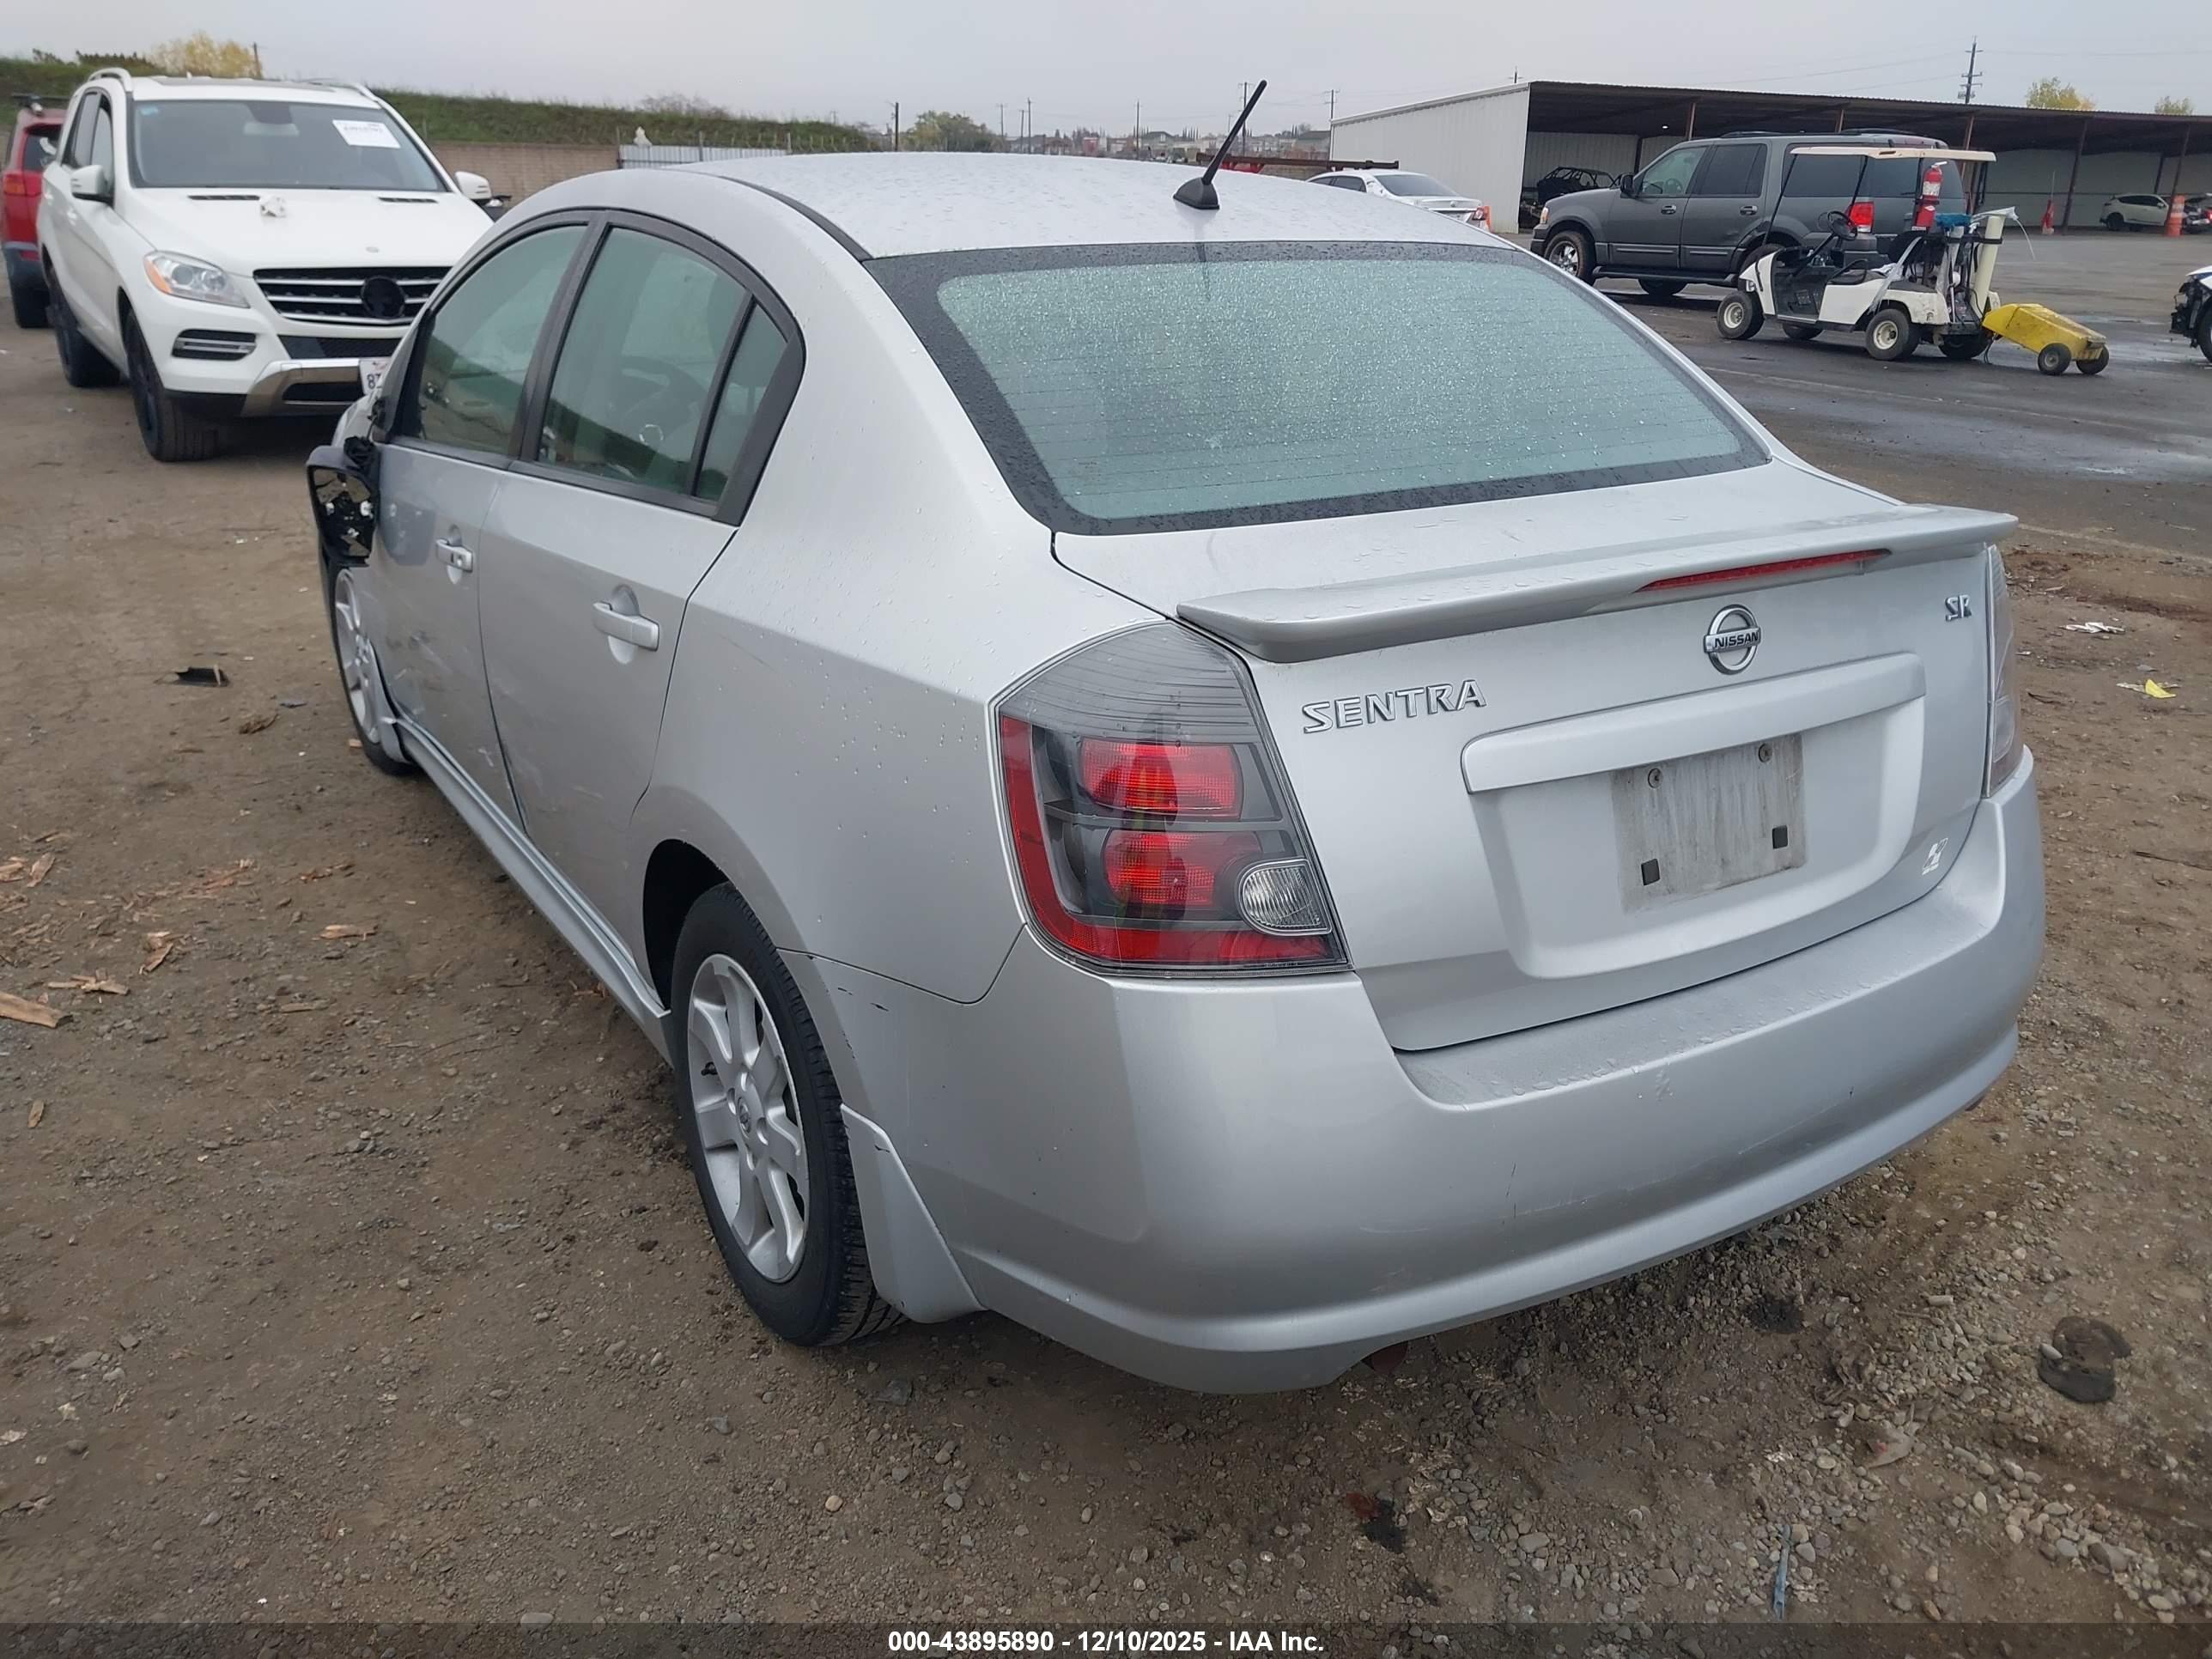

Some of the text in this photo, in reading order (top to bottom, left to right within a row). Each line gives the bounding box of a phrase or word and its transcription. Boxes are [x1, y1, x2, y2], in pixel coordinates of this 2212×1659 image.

[1944, 593, 1972, 622] SR
[1714, 631, 1759, 648] NISSAN
[1302, 678, 1487, 734] SENTRA
